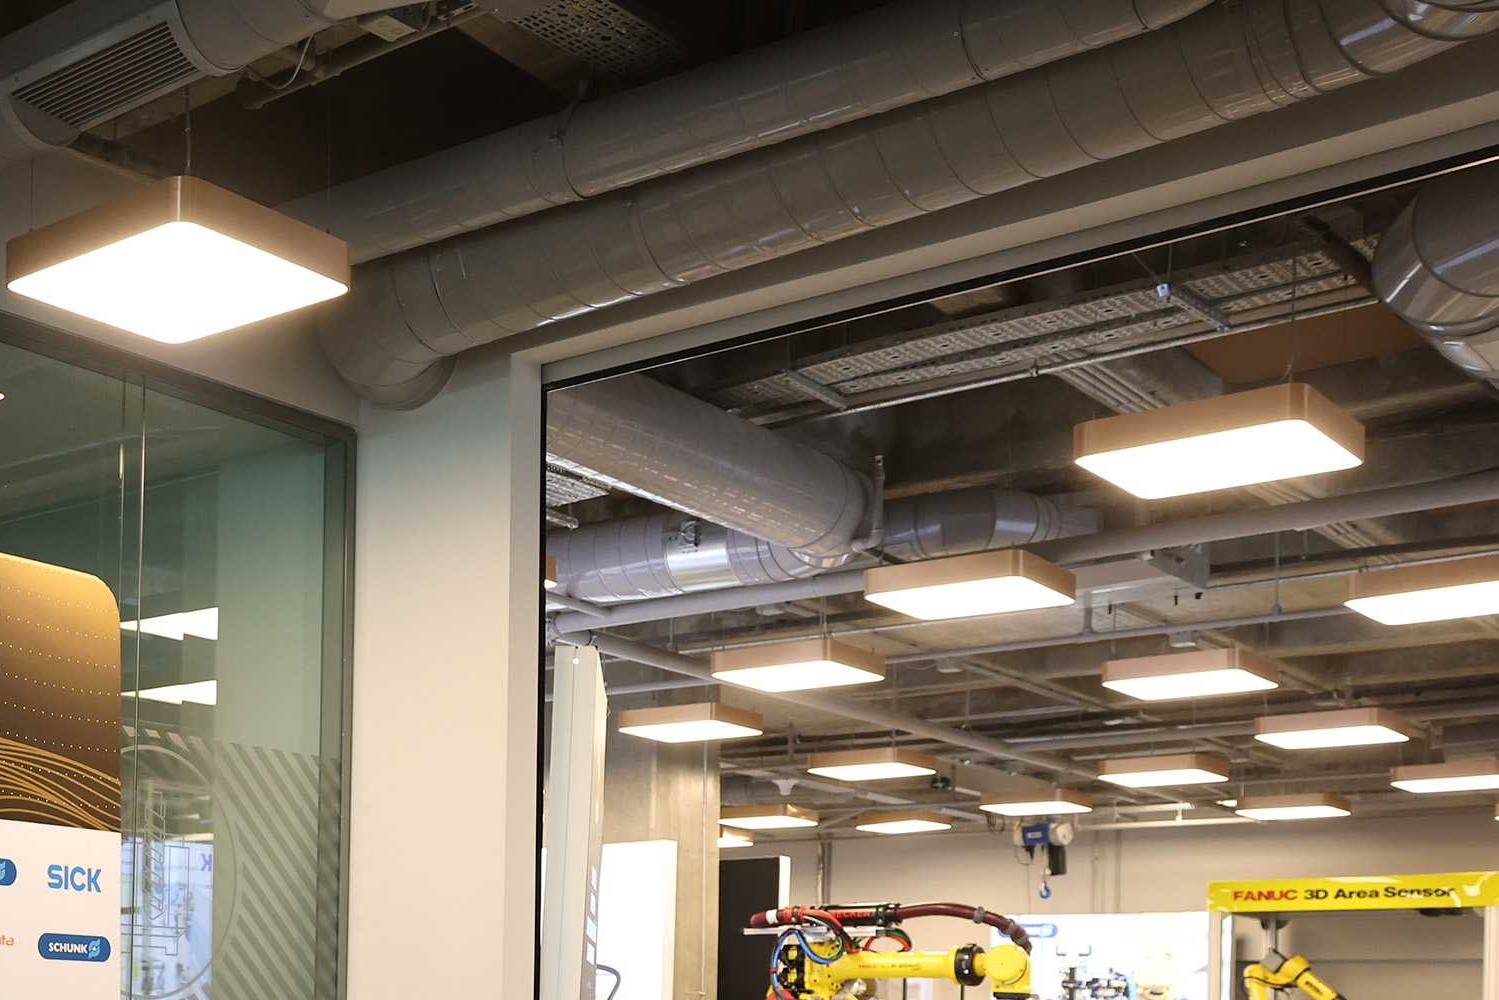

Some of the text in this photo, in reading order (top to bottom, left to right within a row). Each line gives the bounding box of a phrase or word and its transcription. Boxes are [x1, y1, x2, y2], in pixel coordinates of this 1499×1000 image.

[48, 864, 101, 892] SICK
[1233, 886, 1455, 901] FANUC 3D Area Sensor
[49, 942, 87, 953] SCHUNK
